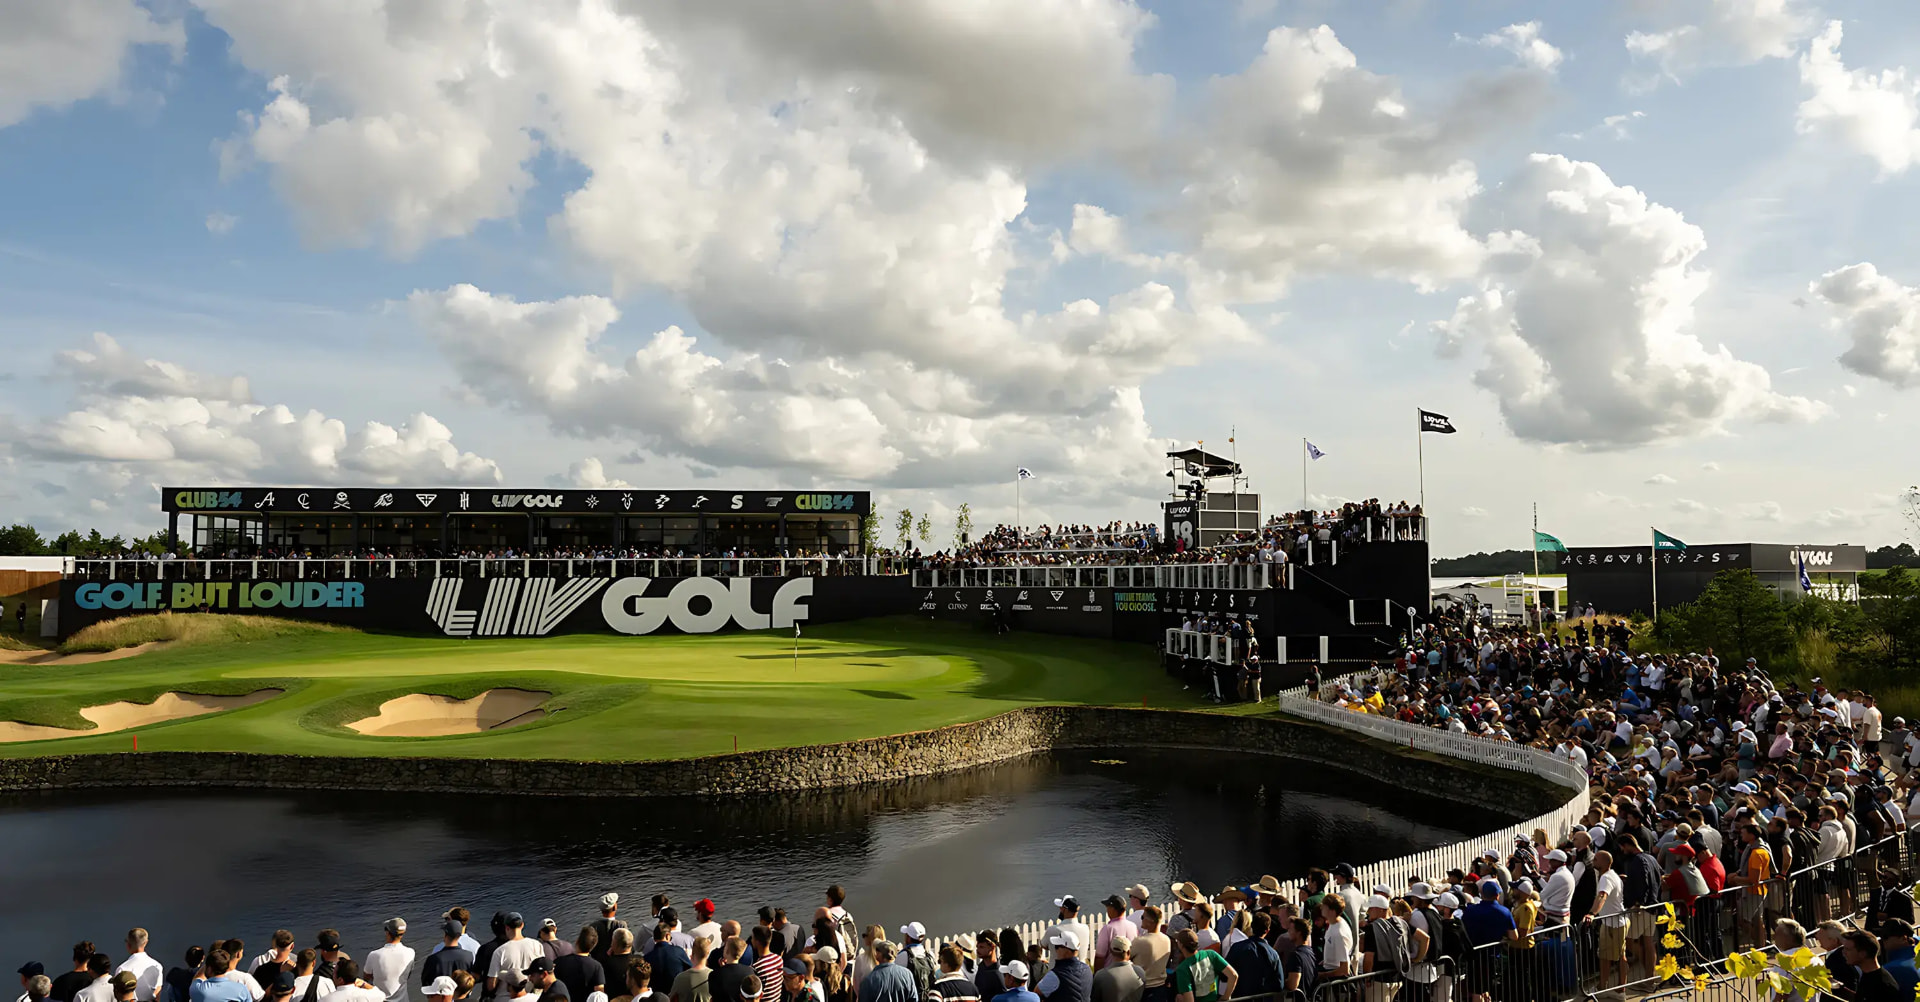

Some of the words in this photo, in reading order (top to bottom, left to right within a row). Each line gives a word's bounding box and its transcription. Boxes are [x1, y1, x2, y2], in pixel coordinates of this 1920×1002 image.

[1172, 521, 1193, 550] 18
[172, 583, 232, 608] BUT
[239, 582, 364, 607] LOUDER
[1116, 602, 1128, 611] YOU
